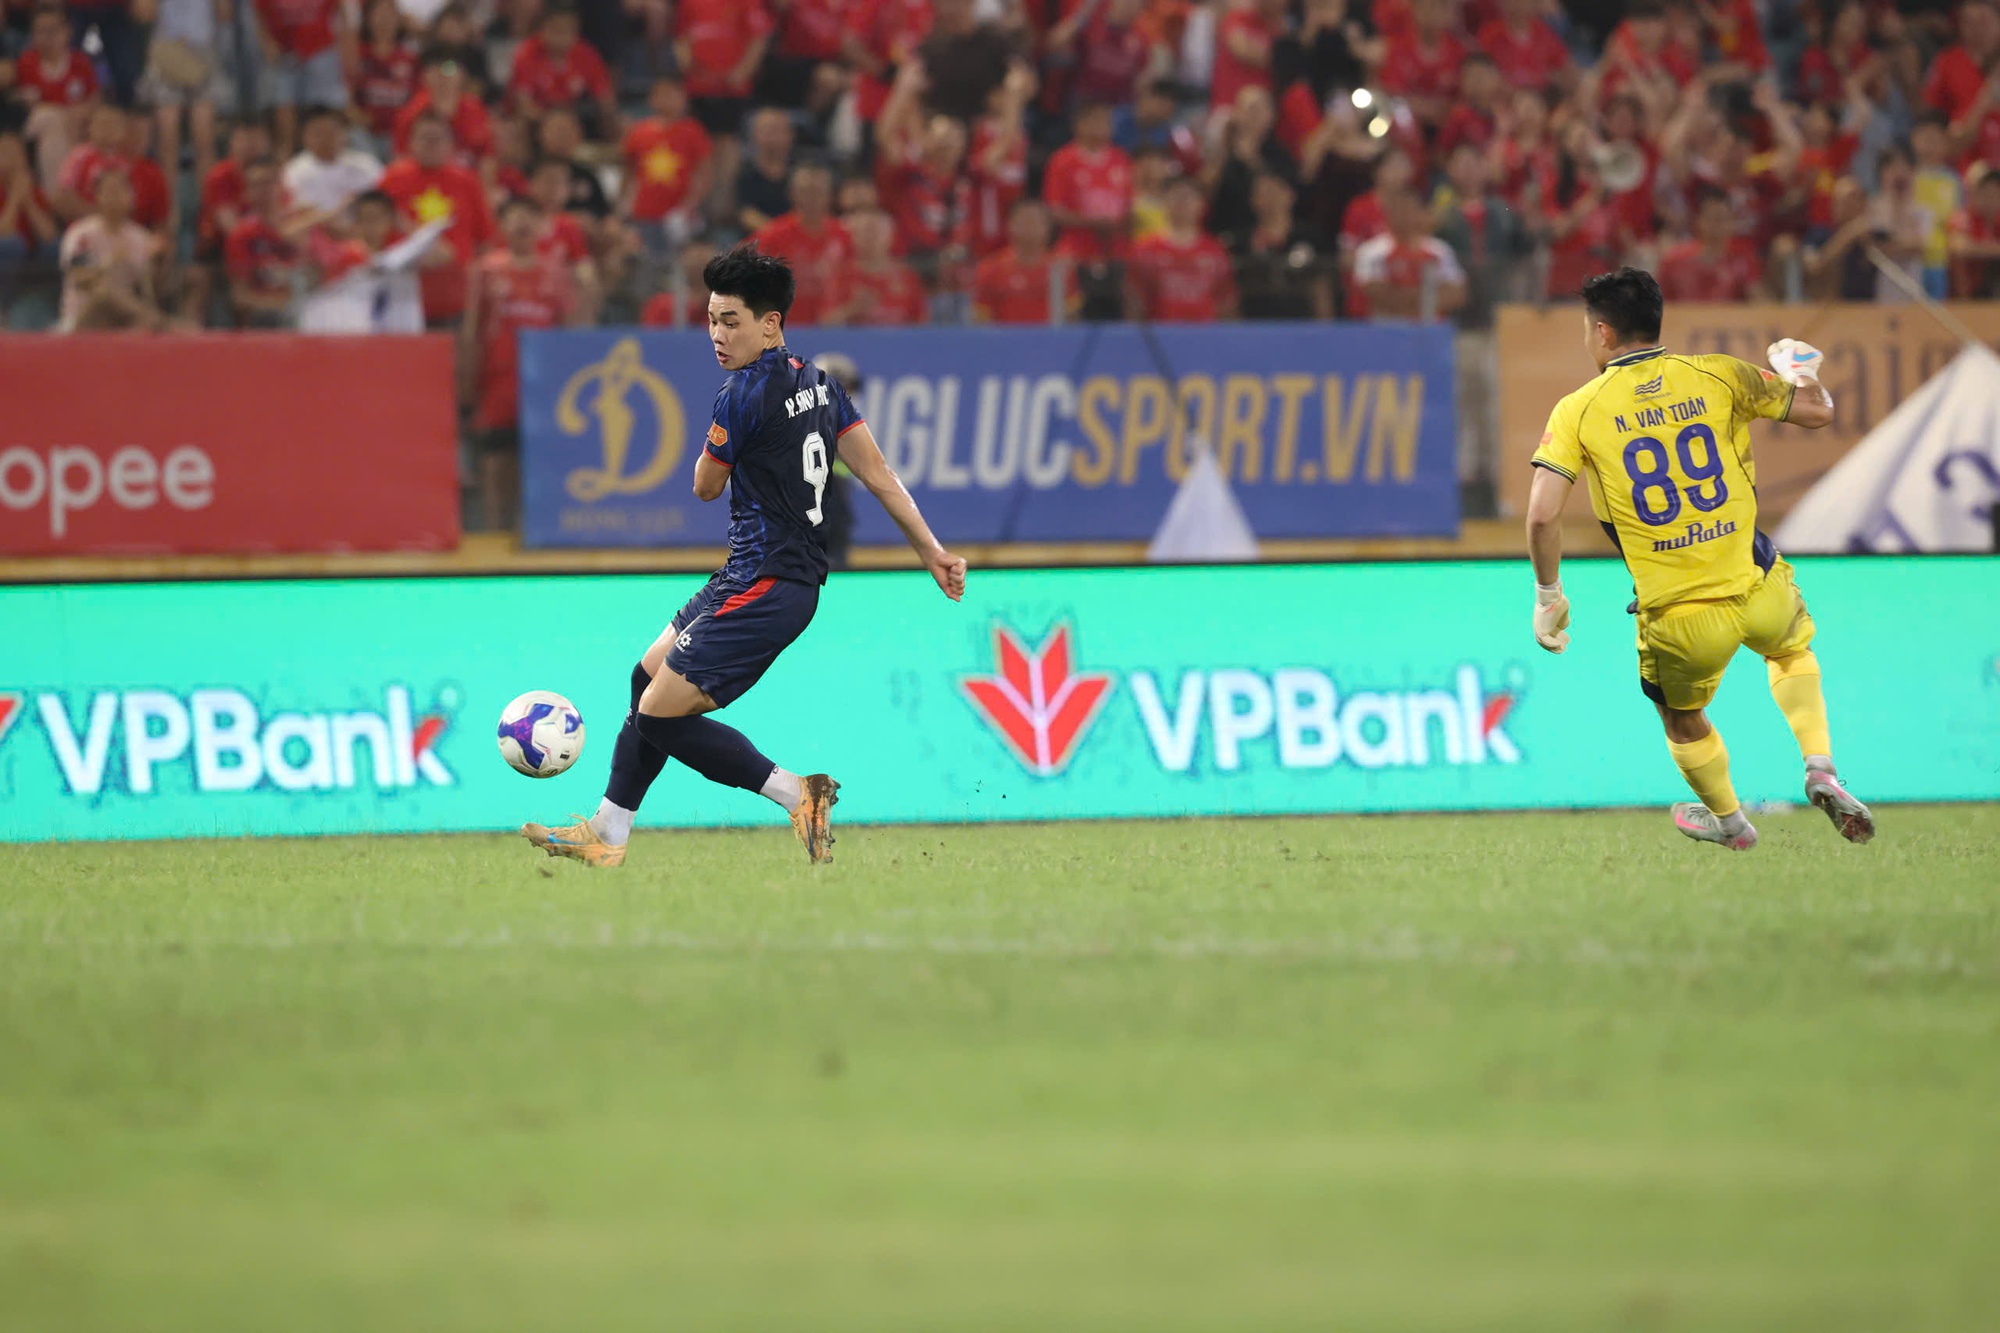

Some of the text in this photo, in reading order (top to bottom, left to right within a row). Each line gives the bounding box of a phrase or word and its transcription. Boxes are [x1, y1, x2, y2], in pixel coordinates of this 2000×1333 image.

[1614, 415, 1632, 434] N.
[1622, 423, 1729, 526] 89
[802, 430, 829, 528] 9
[1651, 520, 1737, 553] muRata
[37, 685, 455, 795] VPBank
[1129, 665, 1521, 771] VPBank
